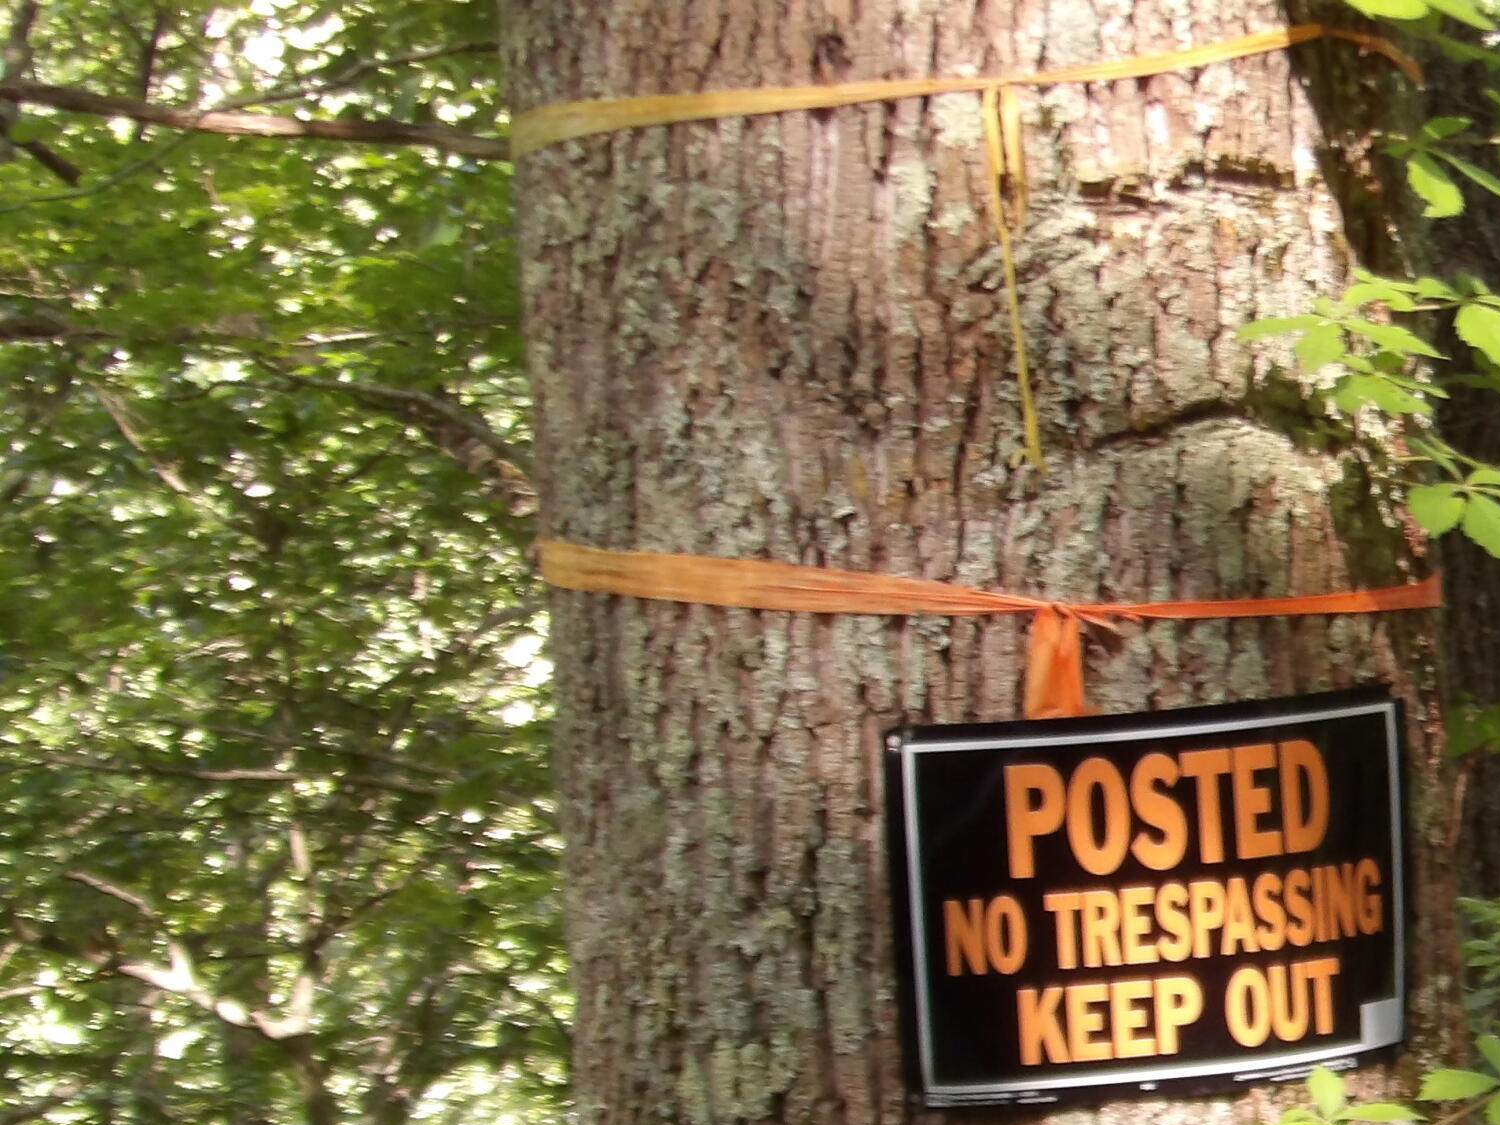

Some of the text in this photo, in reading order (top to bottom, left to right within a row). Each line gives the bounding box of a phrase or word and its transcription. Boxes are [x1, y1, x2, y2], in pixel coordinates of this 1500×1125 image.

[1004, 739, 1330, 879] POSTED
[944, 858, 1382, 976] NO TRESPASSING
[1017, 958, 1340, 1066] KEEP OUT
